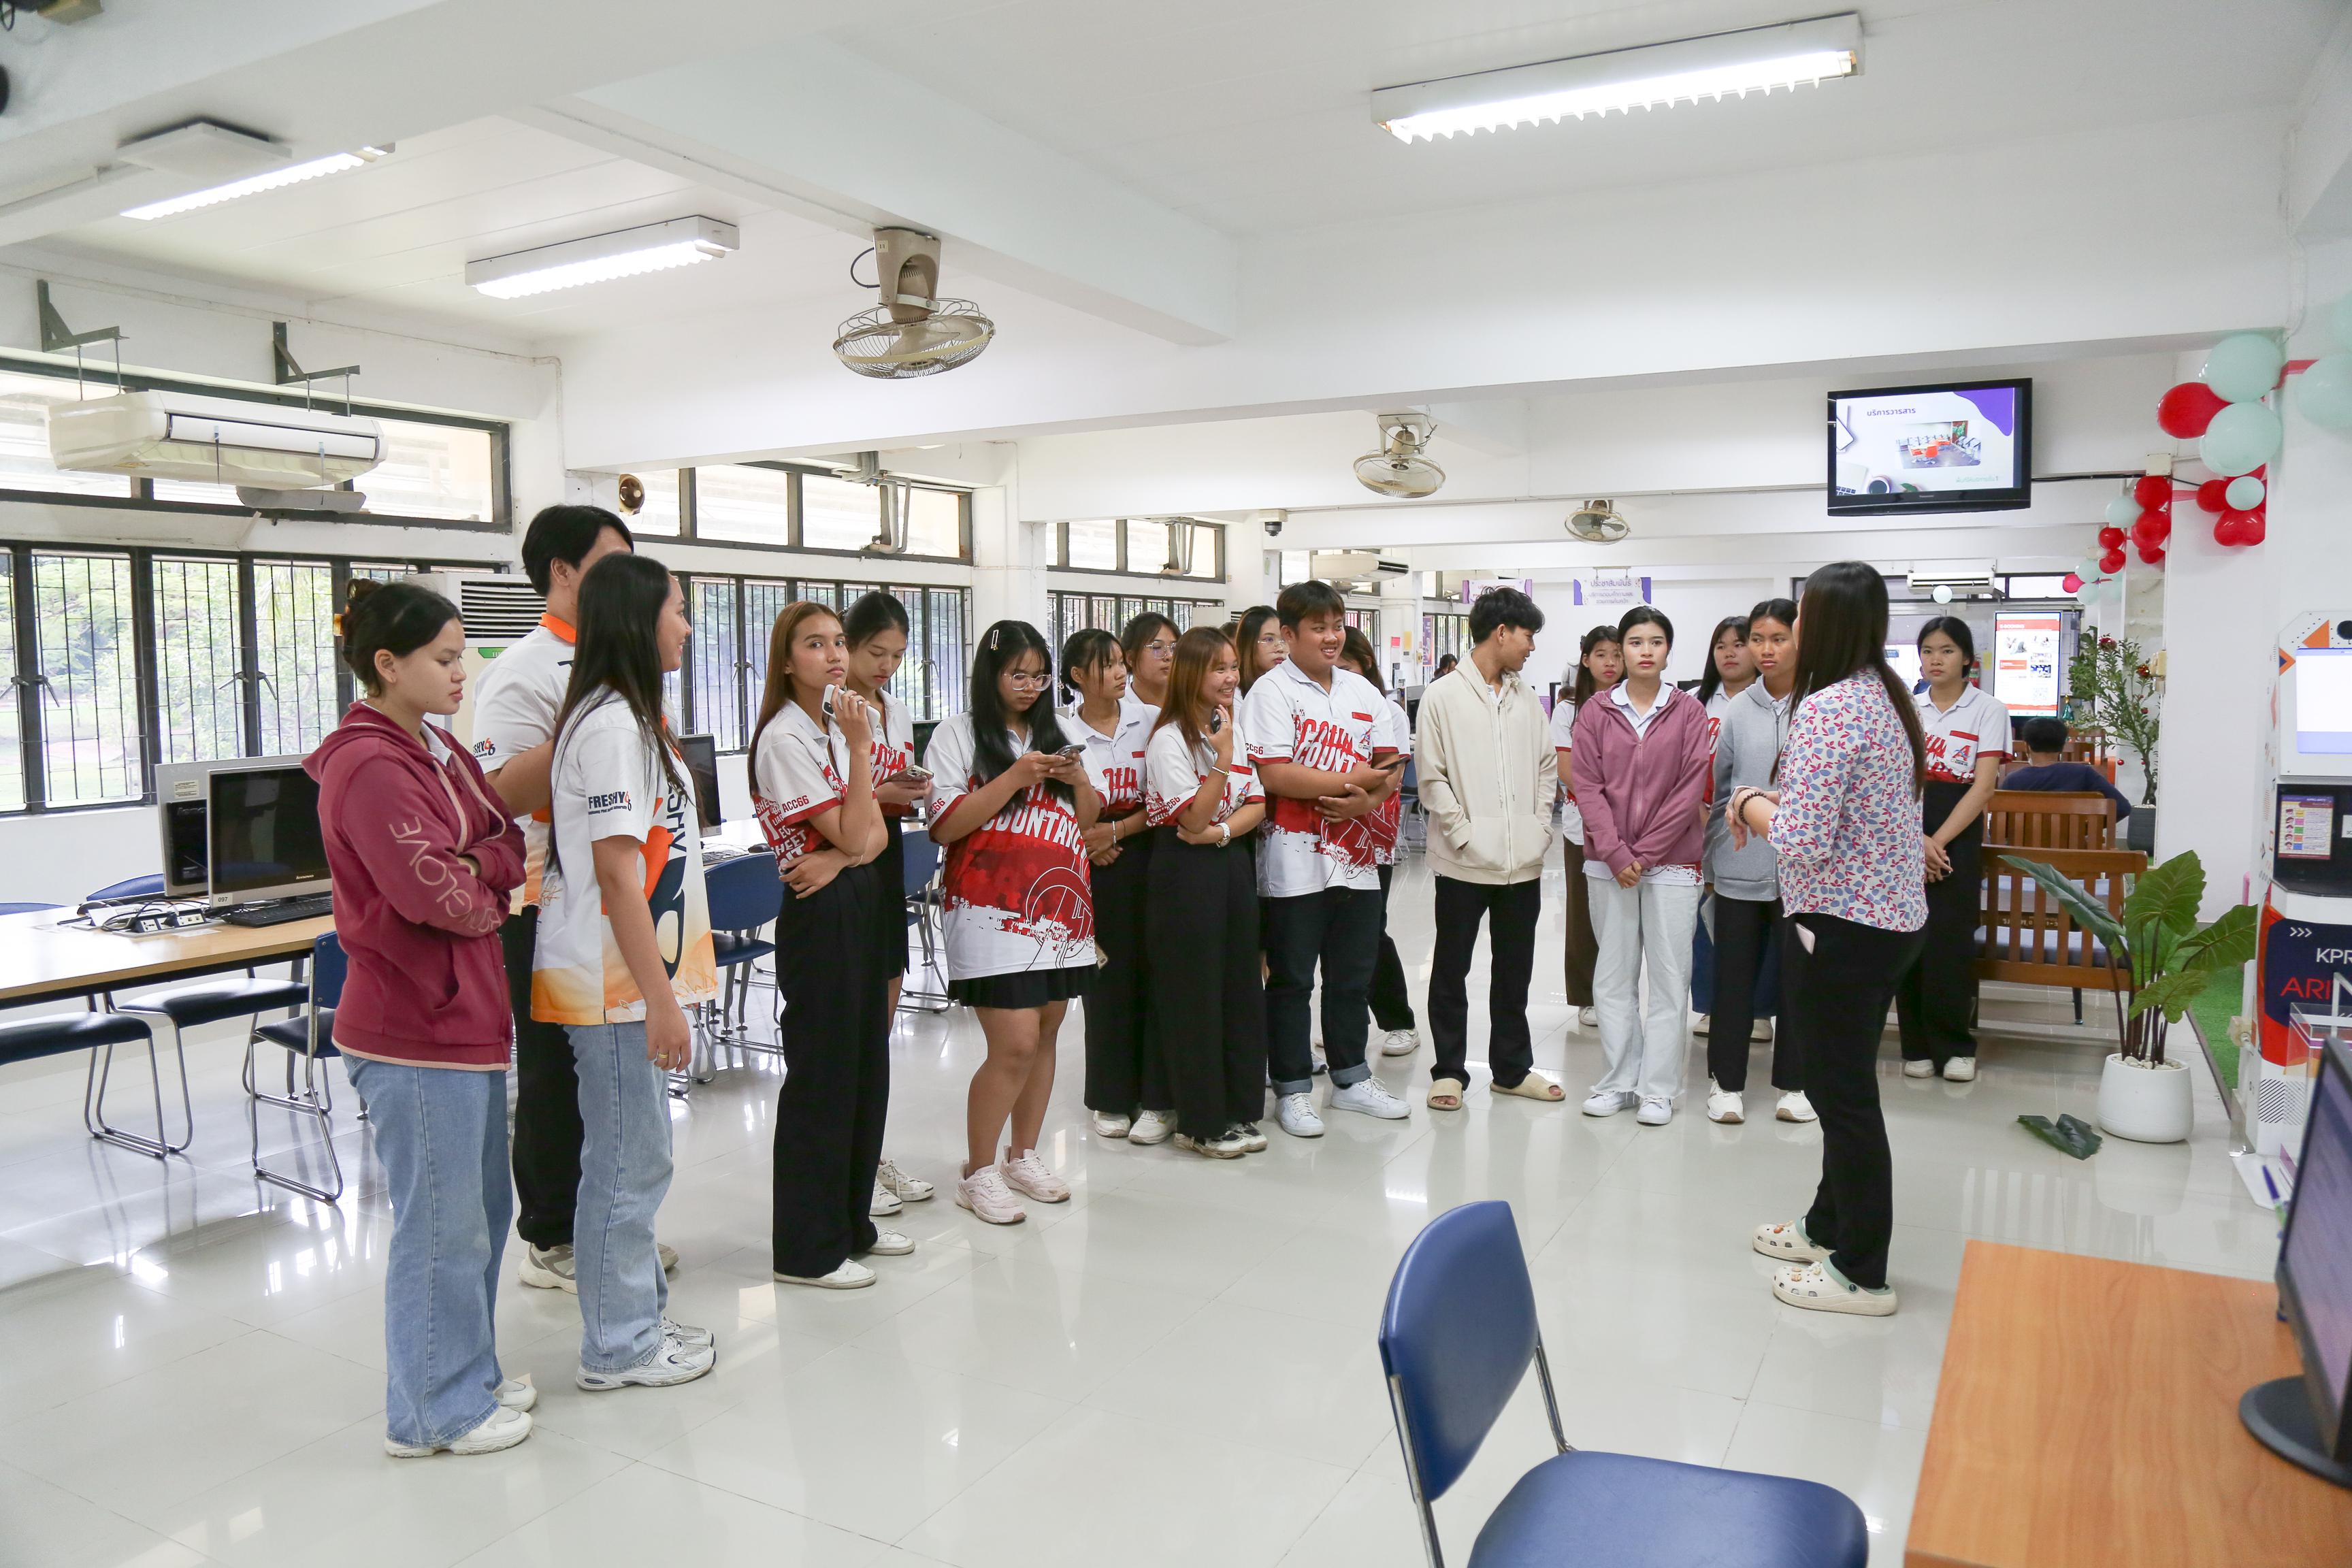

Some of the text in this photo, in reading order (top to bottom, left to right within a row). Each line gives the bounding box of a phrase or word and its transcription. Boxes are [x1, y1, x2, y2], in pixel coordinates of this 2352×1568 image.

[1867, 408, 1916, 416] บริการวารสาร
[1590, 578, 1631, 587] ประชาสัมพันธ์
[783, 795, 809, 813] ACC66
[2281, 976, 2332, 1000] ARI
